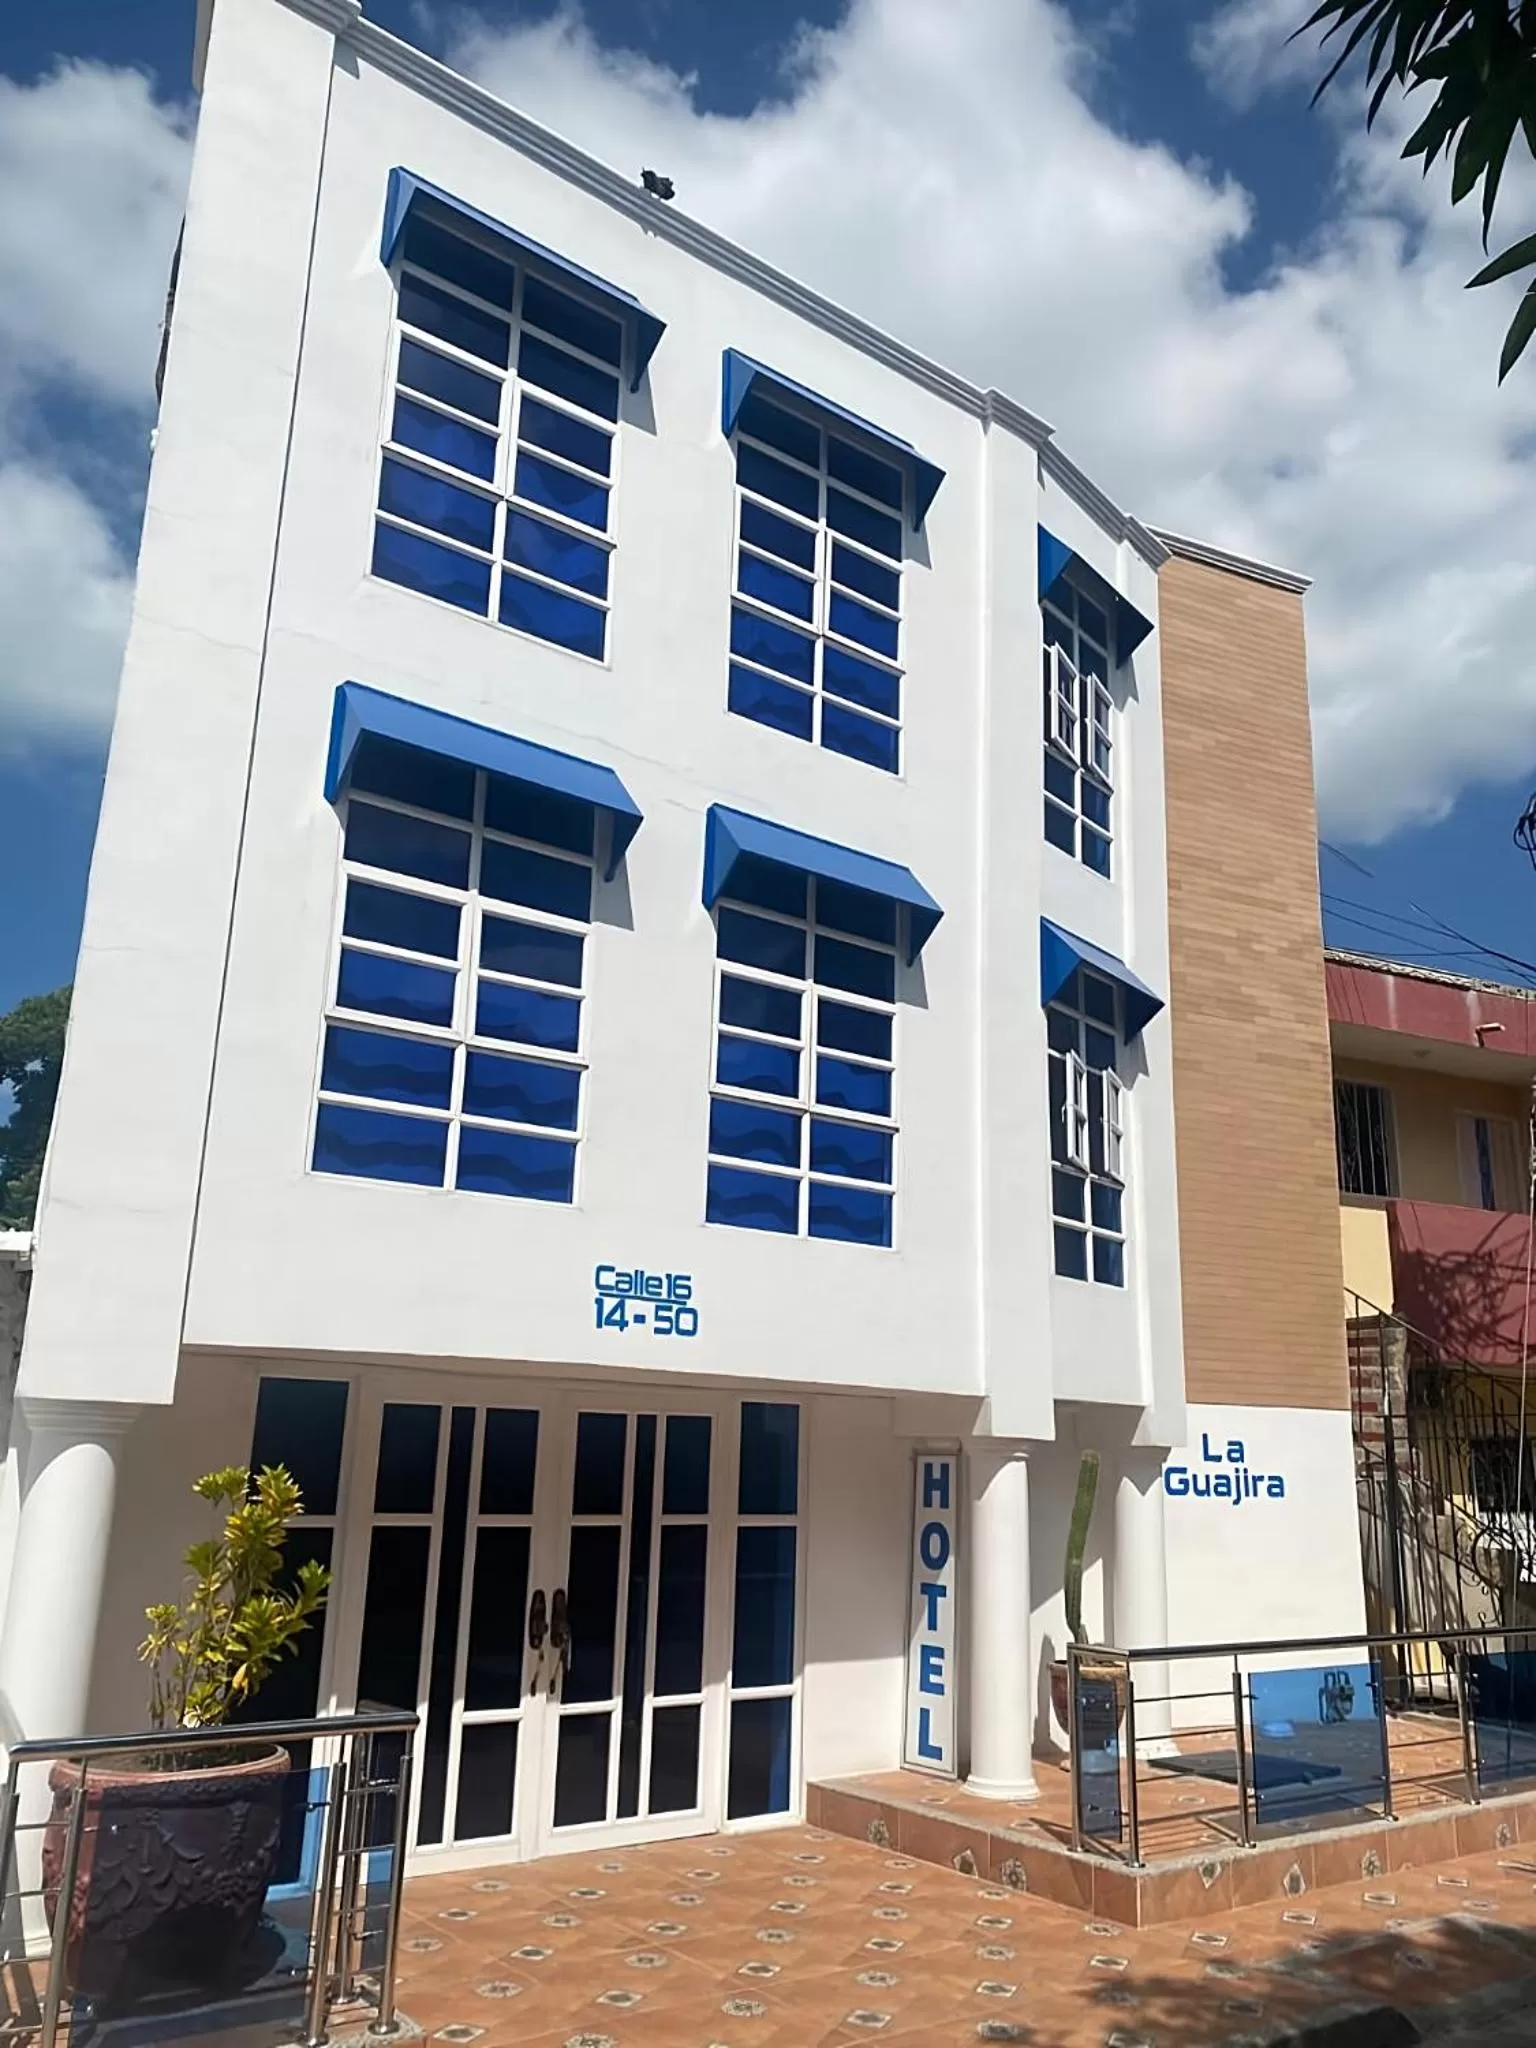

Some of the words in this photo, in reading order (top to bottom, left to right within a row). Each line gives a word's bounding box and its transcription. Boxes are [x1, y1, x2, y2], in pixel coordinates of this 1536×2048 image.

[1202, 1433, 1245, 1463] La
[1164, 1466, 1285, 1506] Guajira
[917, 1462, 950, 1761] HOTEL
